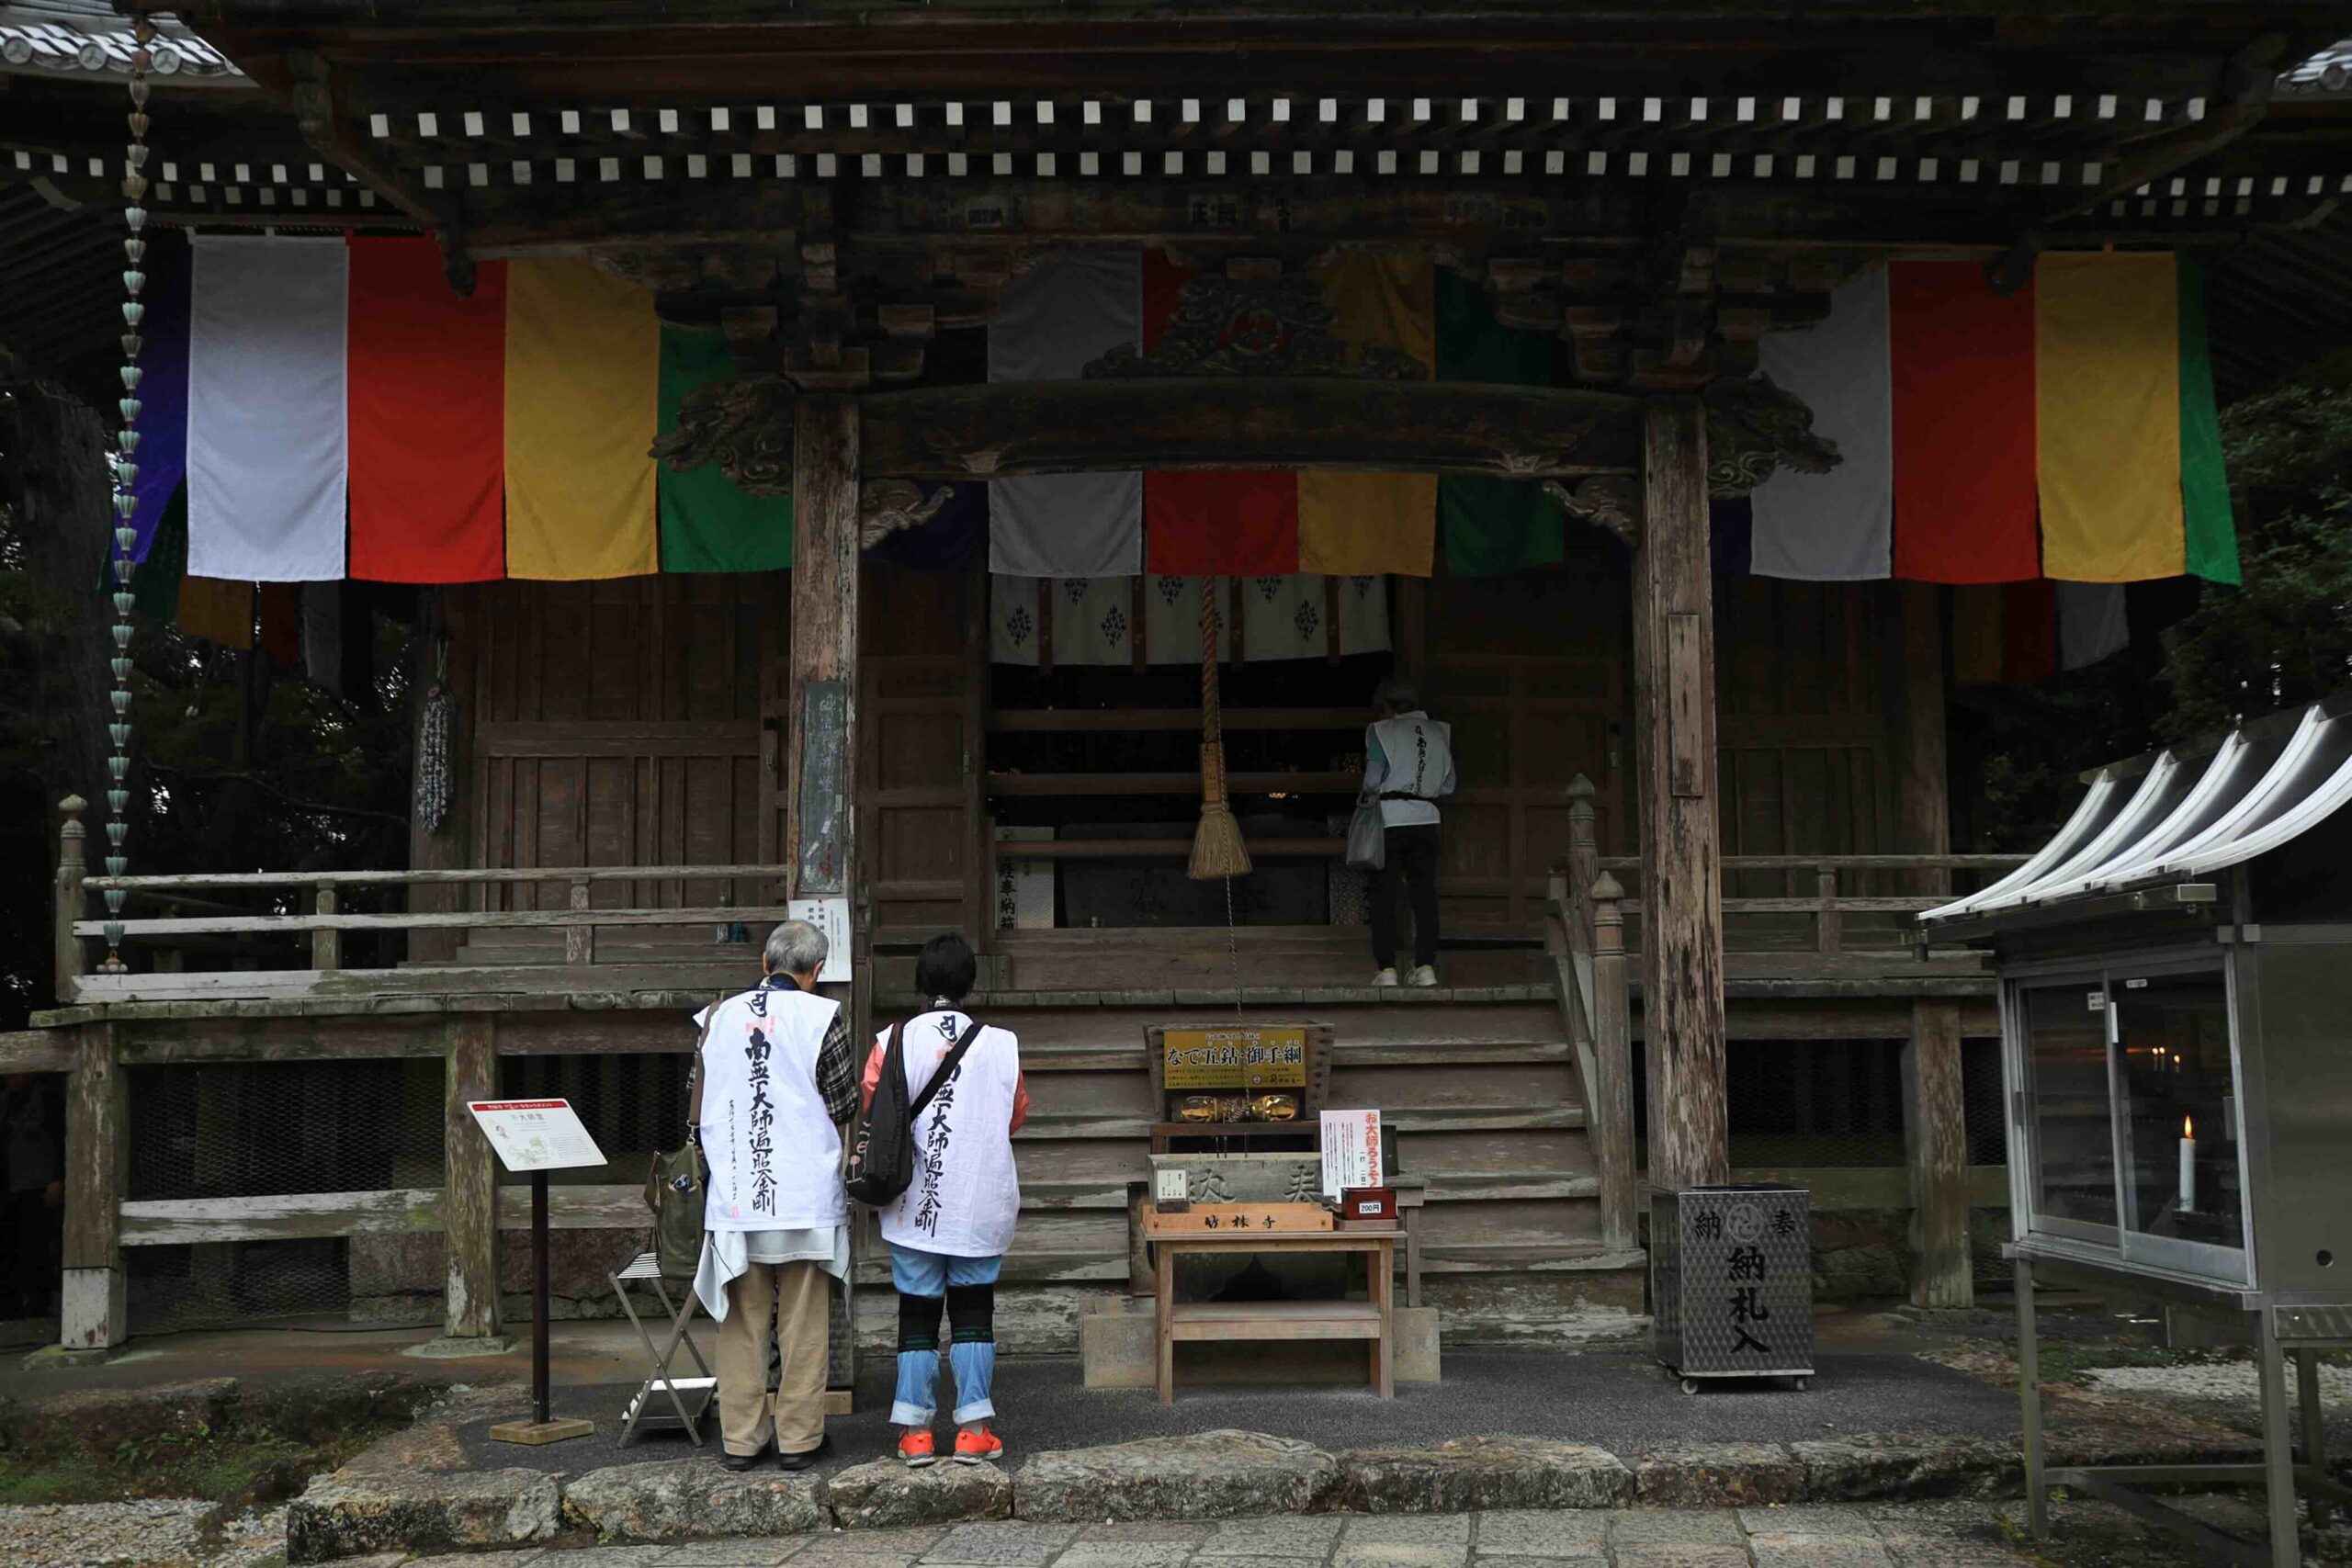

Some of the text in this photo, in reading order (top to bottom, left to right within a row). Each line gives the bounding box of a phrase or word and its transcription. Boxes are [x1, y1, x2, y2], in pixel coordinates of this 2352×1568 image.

[744, 1027, 775, 1217] 南無大師遍照金剛
[1204, 1214, 1276, 1229] 竹林寺
[1361, 1204, 1380, 1213] 200円
[1694, 1210, 1796, 1239] 奉 納
[1727, 1246, 1772, 1354] 納札入
